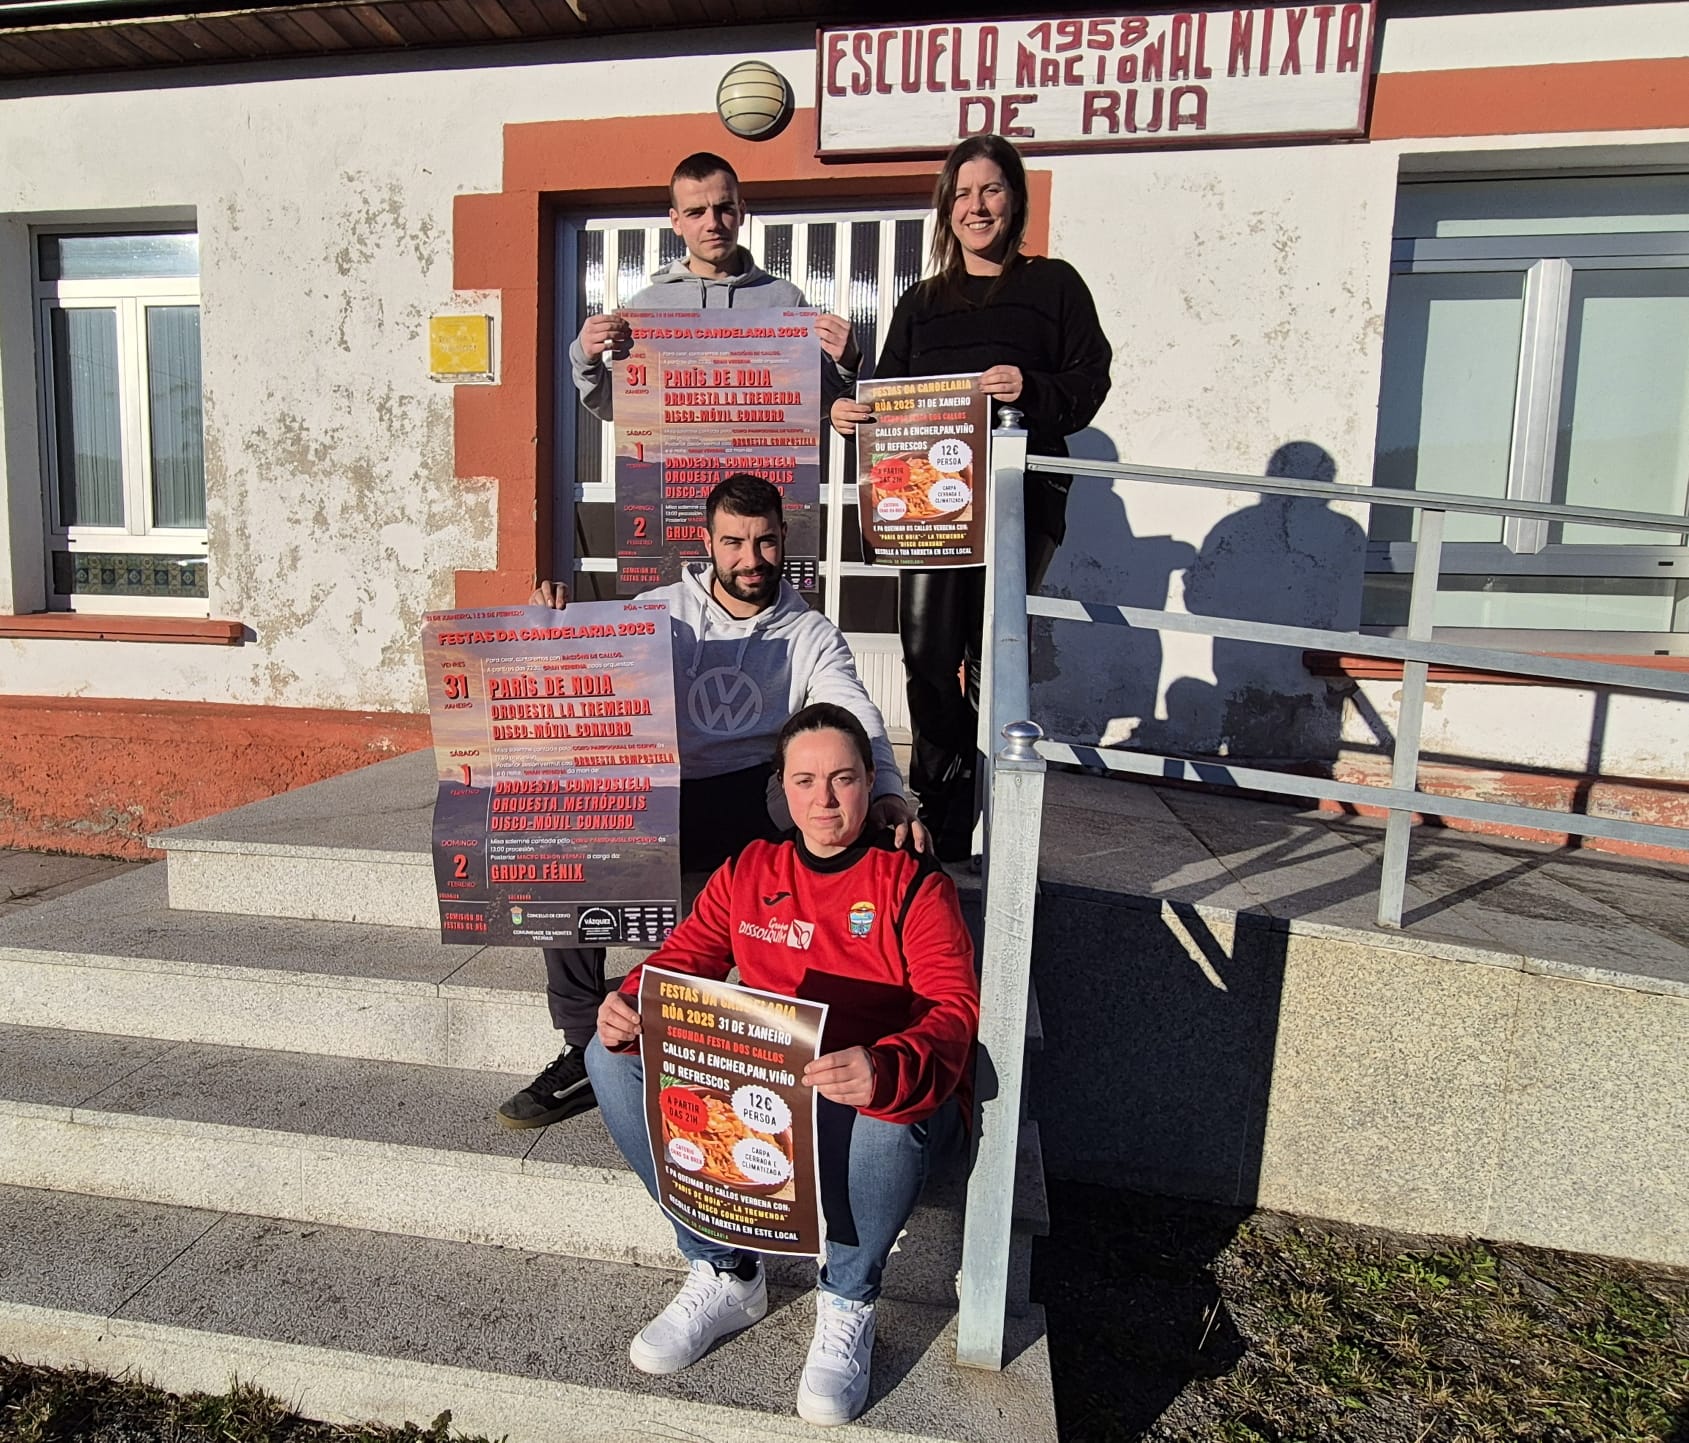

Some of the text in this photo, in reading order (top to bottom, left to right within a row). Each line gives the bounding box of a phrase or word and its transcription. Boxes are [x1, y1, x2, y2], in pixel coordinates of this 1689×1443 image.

[1027, 16, 1149, 53] 1958
[827, 4, 1364, 96] ESCUELA NACIONAL MIXTA
[958, 84, 1209, 139] DE RUA
[633, 327, 673, 340] ESTAS
[674, 327, 694, 339] DA
[695, 327, 777, 340] CANDELARIA
[627, 363, 647, 386] 31
[712, 369, 731, 386] DE
[737, 368, 772, 386] NOIA
[918, 378, 972, 394] CANDELARIA
[664, 391, 801, 405] ORQUESTA LA TREMENDA
[875, 396, 971, 412] RÚA 2025 31 DE XANEIRO
[875, 427, 903, 438] CALLOS
[903, 426, 911, 437] A
[875, 440, 928, 452] OU REFRESCOS
[665, 456, 720, 469] ORQUESTA
[724, 455, 797, 469] COMPOSTELA
[936, 457, 962, 466] PERSOA
[665, 471, 720, 483] ORQUESTA
[633, 516, 647, 538] 2
[666, 526, 704, 539] GRUPO
[438, 630, 494, 646] FESTAS
[495, 629, 518, 642] DA
[519, 624, 616, 642] CANDELARIA
[443, 673, 469, 700] 31
[489, 674, 613, 699] PARÍS DE NOIA
[490, 698, 653, 720] ORQUESTA LA TREMENDA
[492, 721, 633, 740] DISCO-MÓVIL CONXURO
[574, 753, 675, 767] ORQUESTA COMPOSTELA
[461, 763, 472, 788] 1
[495, 778, 560, 796] ORQUESTA
[565, 777, 651, 793] COMPOSTELA
[492, 793, 646, 812] ORQUESTA METRÓPOLIS
[491, 813, 634, 831] DISCO-MÓVIL CONXURO
[441, 839, 478, 848] DOMINGO
[453, 853, 469, 880] 2
[491, 860, 584, 881] GRUPO FÉNIX
[659, 981, 699, 1004] FESTAS
[662, 1002, 792, 1046] RÚA 2025 31 DE XANEIRO
[662, 1041, 696, 1062] CALLOS
[697, 1050, 705, 1064] A
[667, 1025, 784, 1064] SEGUNDA FESTA DOS CALLOS
[662, 1060, 730, 1092] OU REFRESCOS
[673, 1097, 700, 1114] PARTIR
[669, 1107, 698, 1125] DAS 21H
[743, 1108, 777, 1126] PERSOA
[744, 1153, 772, 1166] CERRADA
[751, 1146, 771, 1158] CARPA
[741, 1160, 782, 1177] CLIMATIZADA
[669, 1168, 677, 1178] PA
[677, 1173, 704, 1190] QUEIMAR
[704, 1183, 714, 1194] OS
[714, 1187, 739, 1201] CALLOS
[740, 1194, 772, 1209] VERBENA
[693, 1190, 703, 1200] DE
[733, 1204, 743, 1213] LA
[668, 1193, 691, 1215] RECOLLE
[691, 1208, 698, 1218] A
[697, 1210, 710, 1224] TUA
[710, 1216, 741, 1233] TARXETA
[742, 1226, 753, 1235] EN
[754, 1228, 773, 1238] ESTE
[774, 1230, 799, 1241] LOCAL
